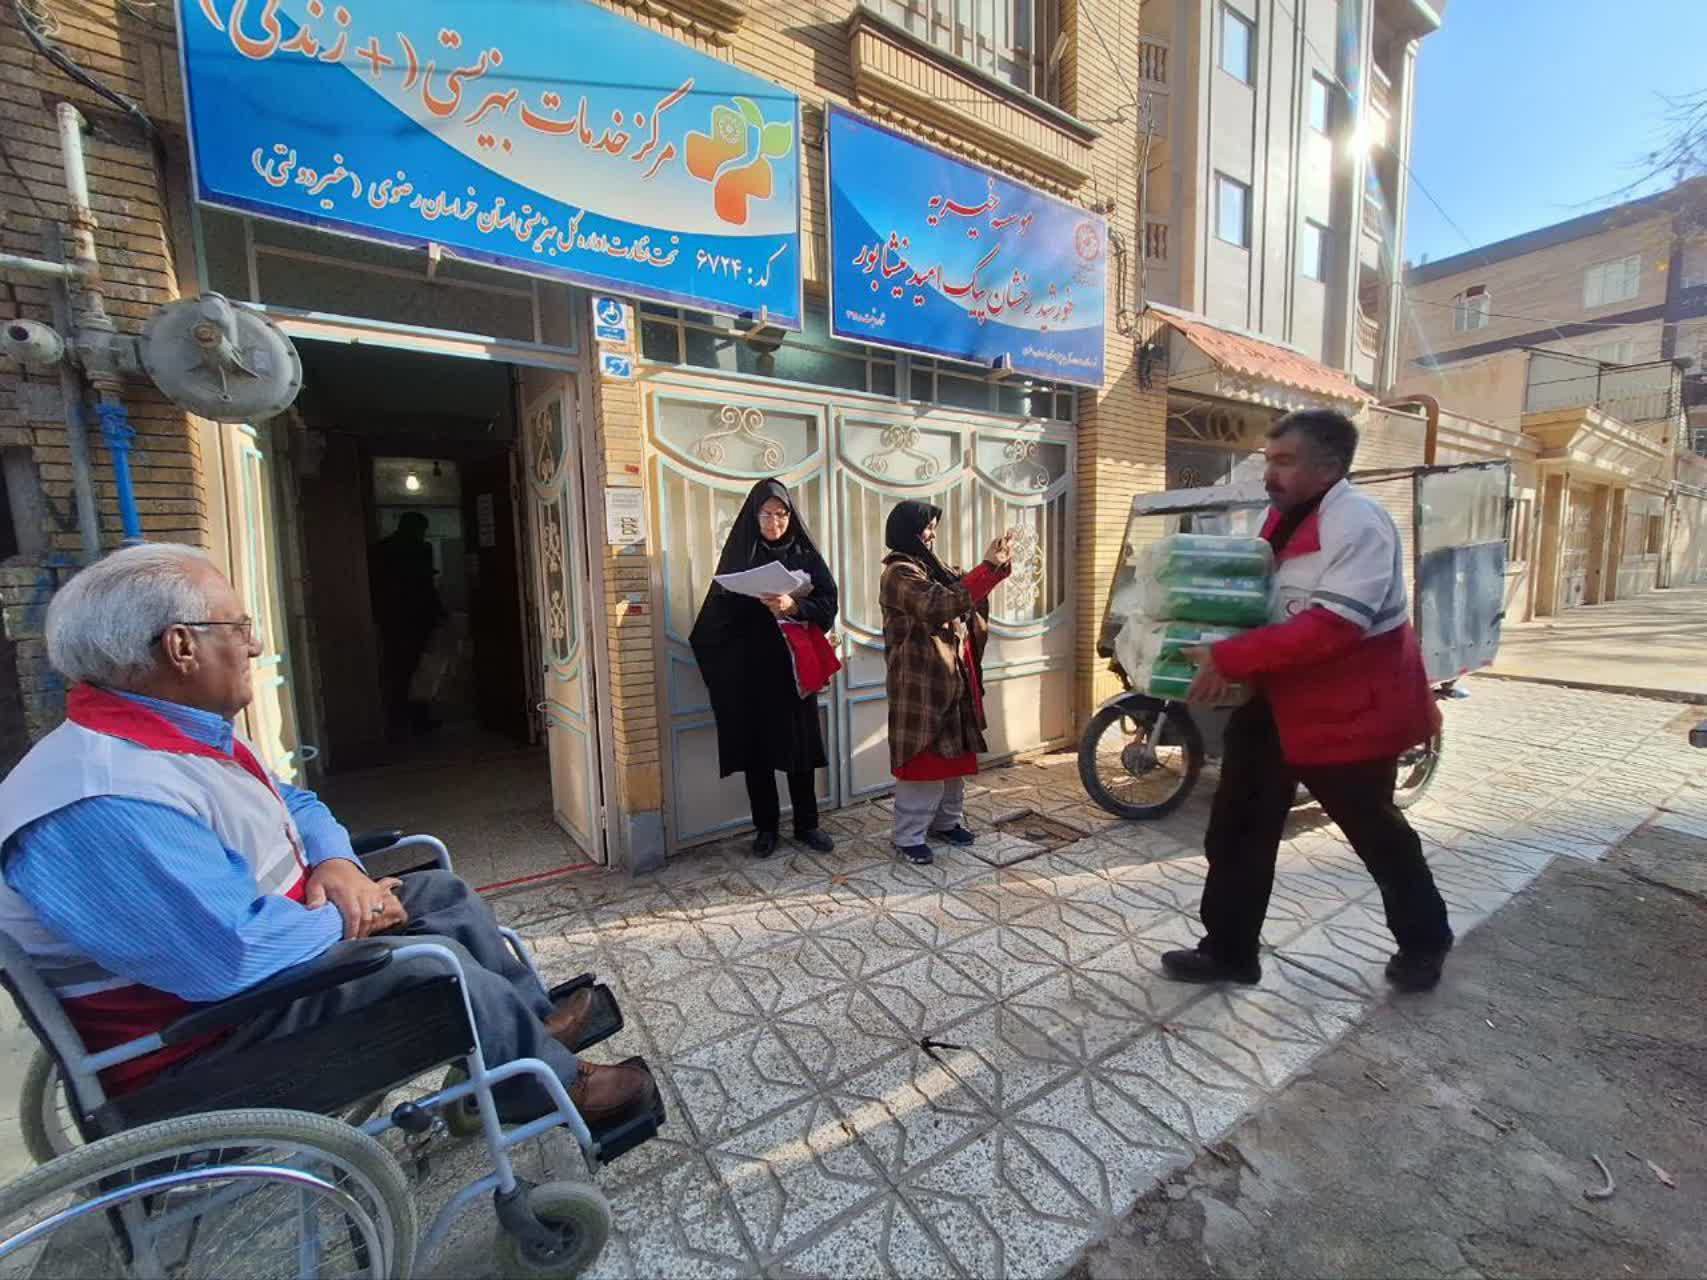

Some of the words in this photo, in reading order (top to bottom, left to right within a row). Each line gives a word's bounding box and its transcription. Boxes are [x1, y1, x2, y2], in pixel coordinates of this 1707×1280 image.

[422, 28, 519, 155] بهزیستی
[520, 91, 631, 156] خدمات
[629, 78, 694, 181] مرکز
[368, 170, 423, 208] رضوی
[420, 186, 478, 221] خراسان
[927, 176, 1001, 240] خیریه
[476, 197, 516, 233] استان
[514, 205, 558, 256] بهزیستی
[557, 208, 585, 252] کل
[576, 231, 609, 252] اداره
[607, 235, 650, 263] نظارت
[649, 235, 680, 267] تحت
[852, 230, 909, 298] نیشابور
[906, 264, 943, 306] امید
